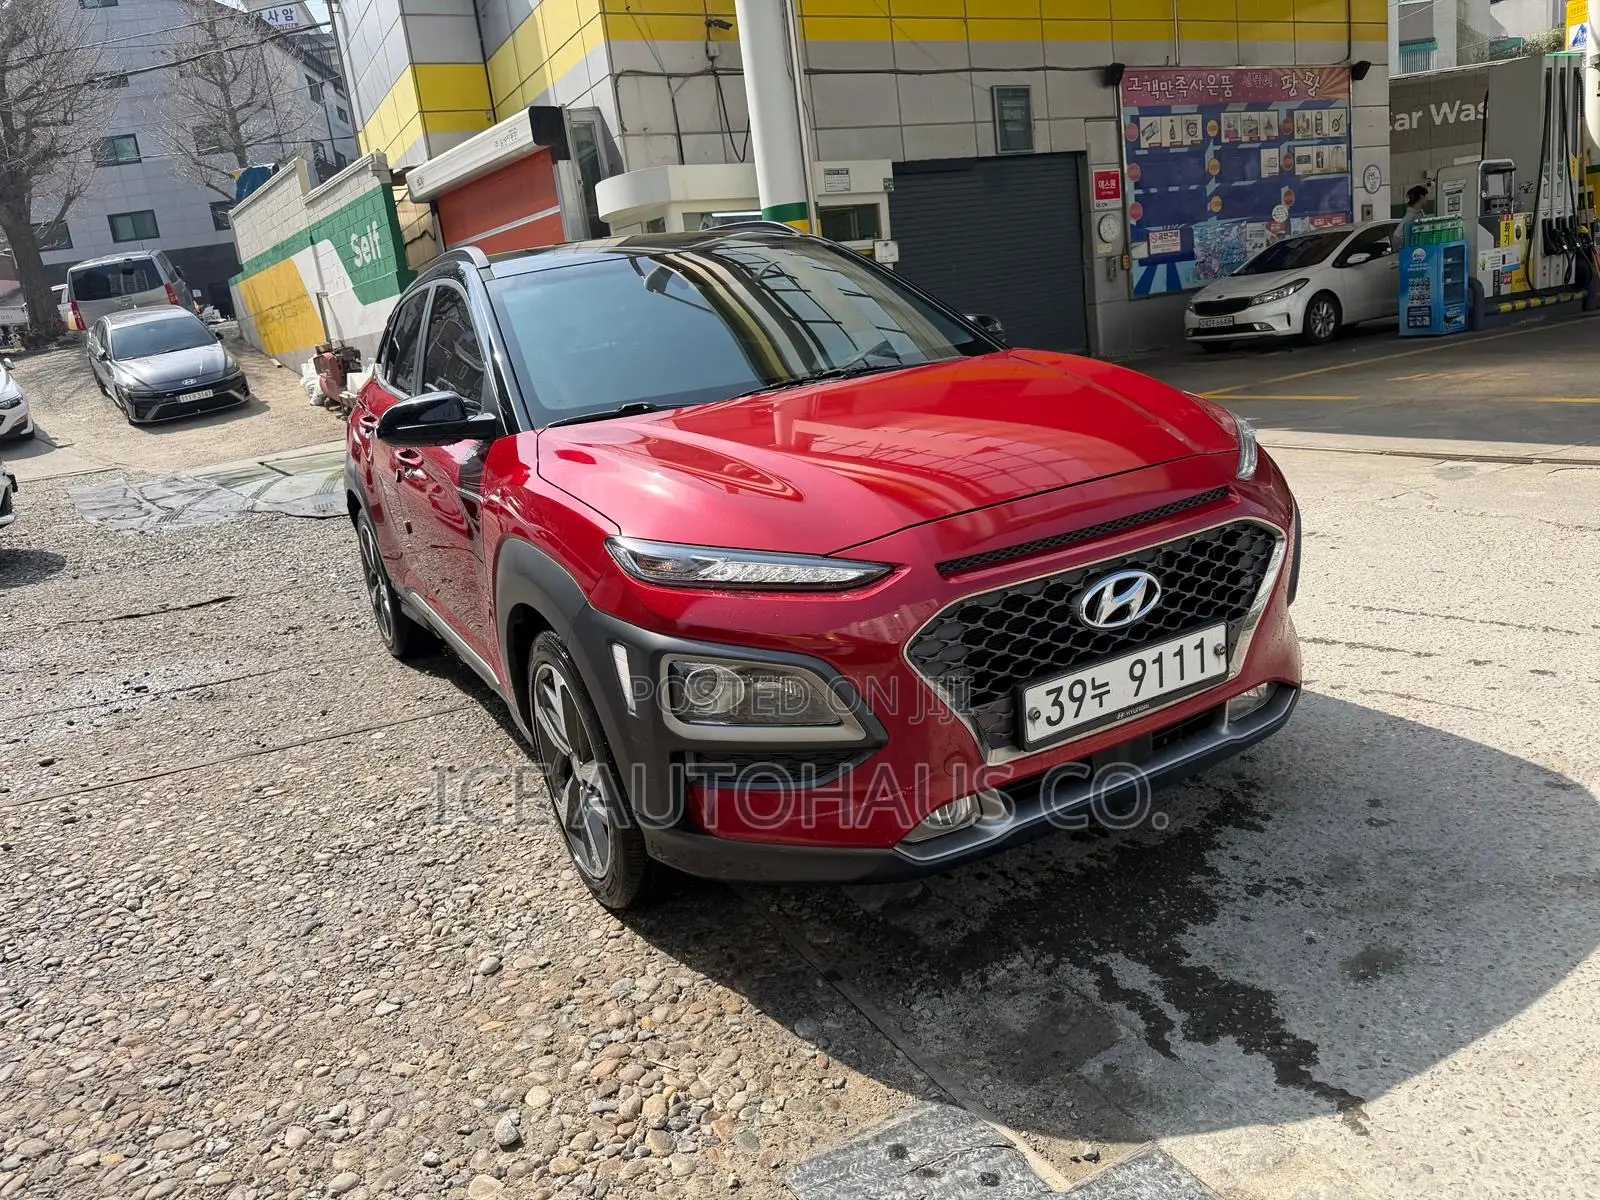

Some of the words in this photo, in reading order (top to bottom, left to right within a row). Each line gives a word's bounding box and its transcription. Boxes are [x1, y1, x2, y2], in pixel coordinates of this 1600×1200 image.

[1388, 110, 1423, 131] ar
[1429, 99, 1489, 126] Was
[350, 220, 382, 267] Self
[1045, 677, 1112, 727] 39누
[1129, 637, 1205, 697] 9111
